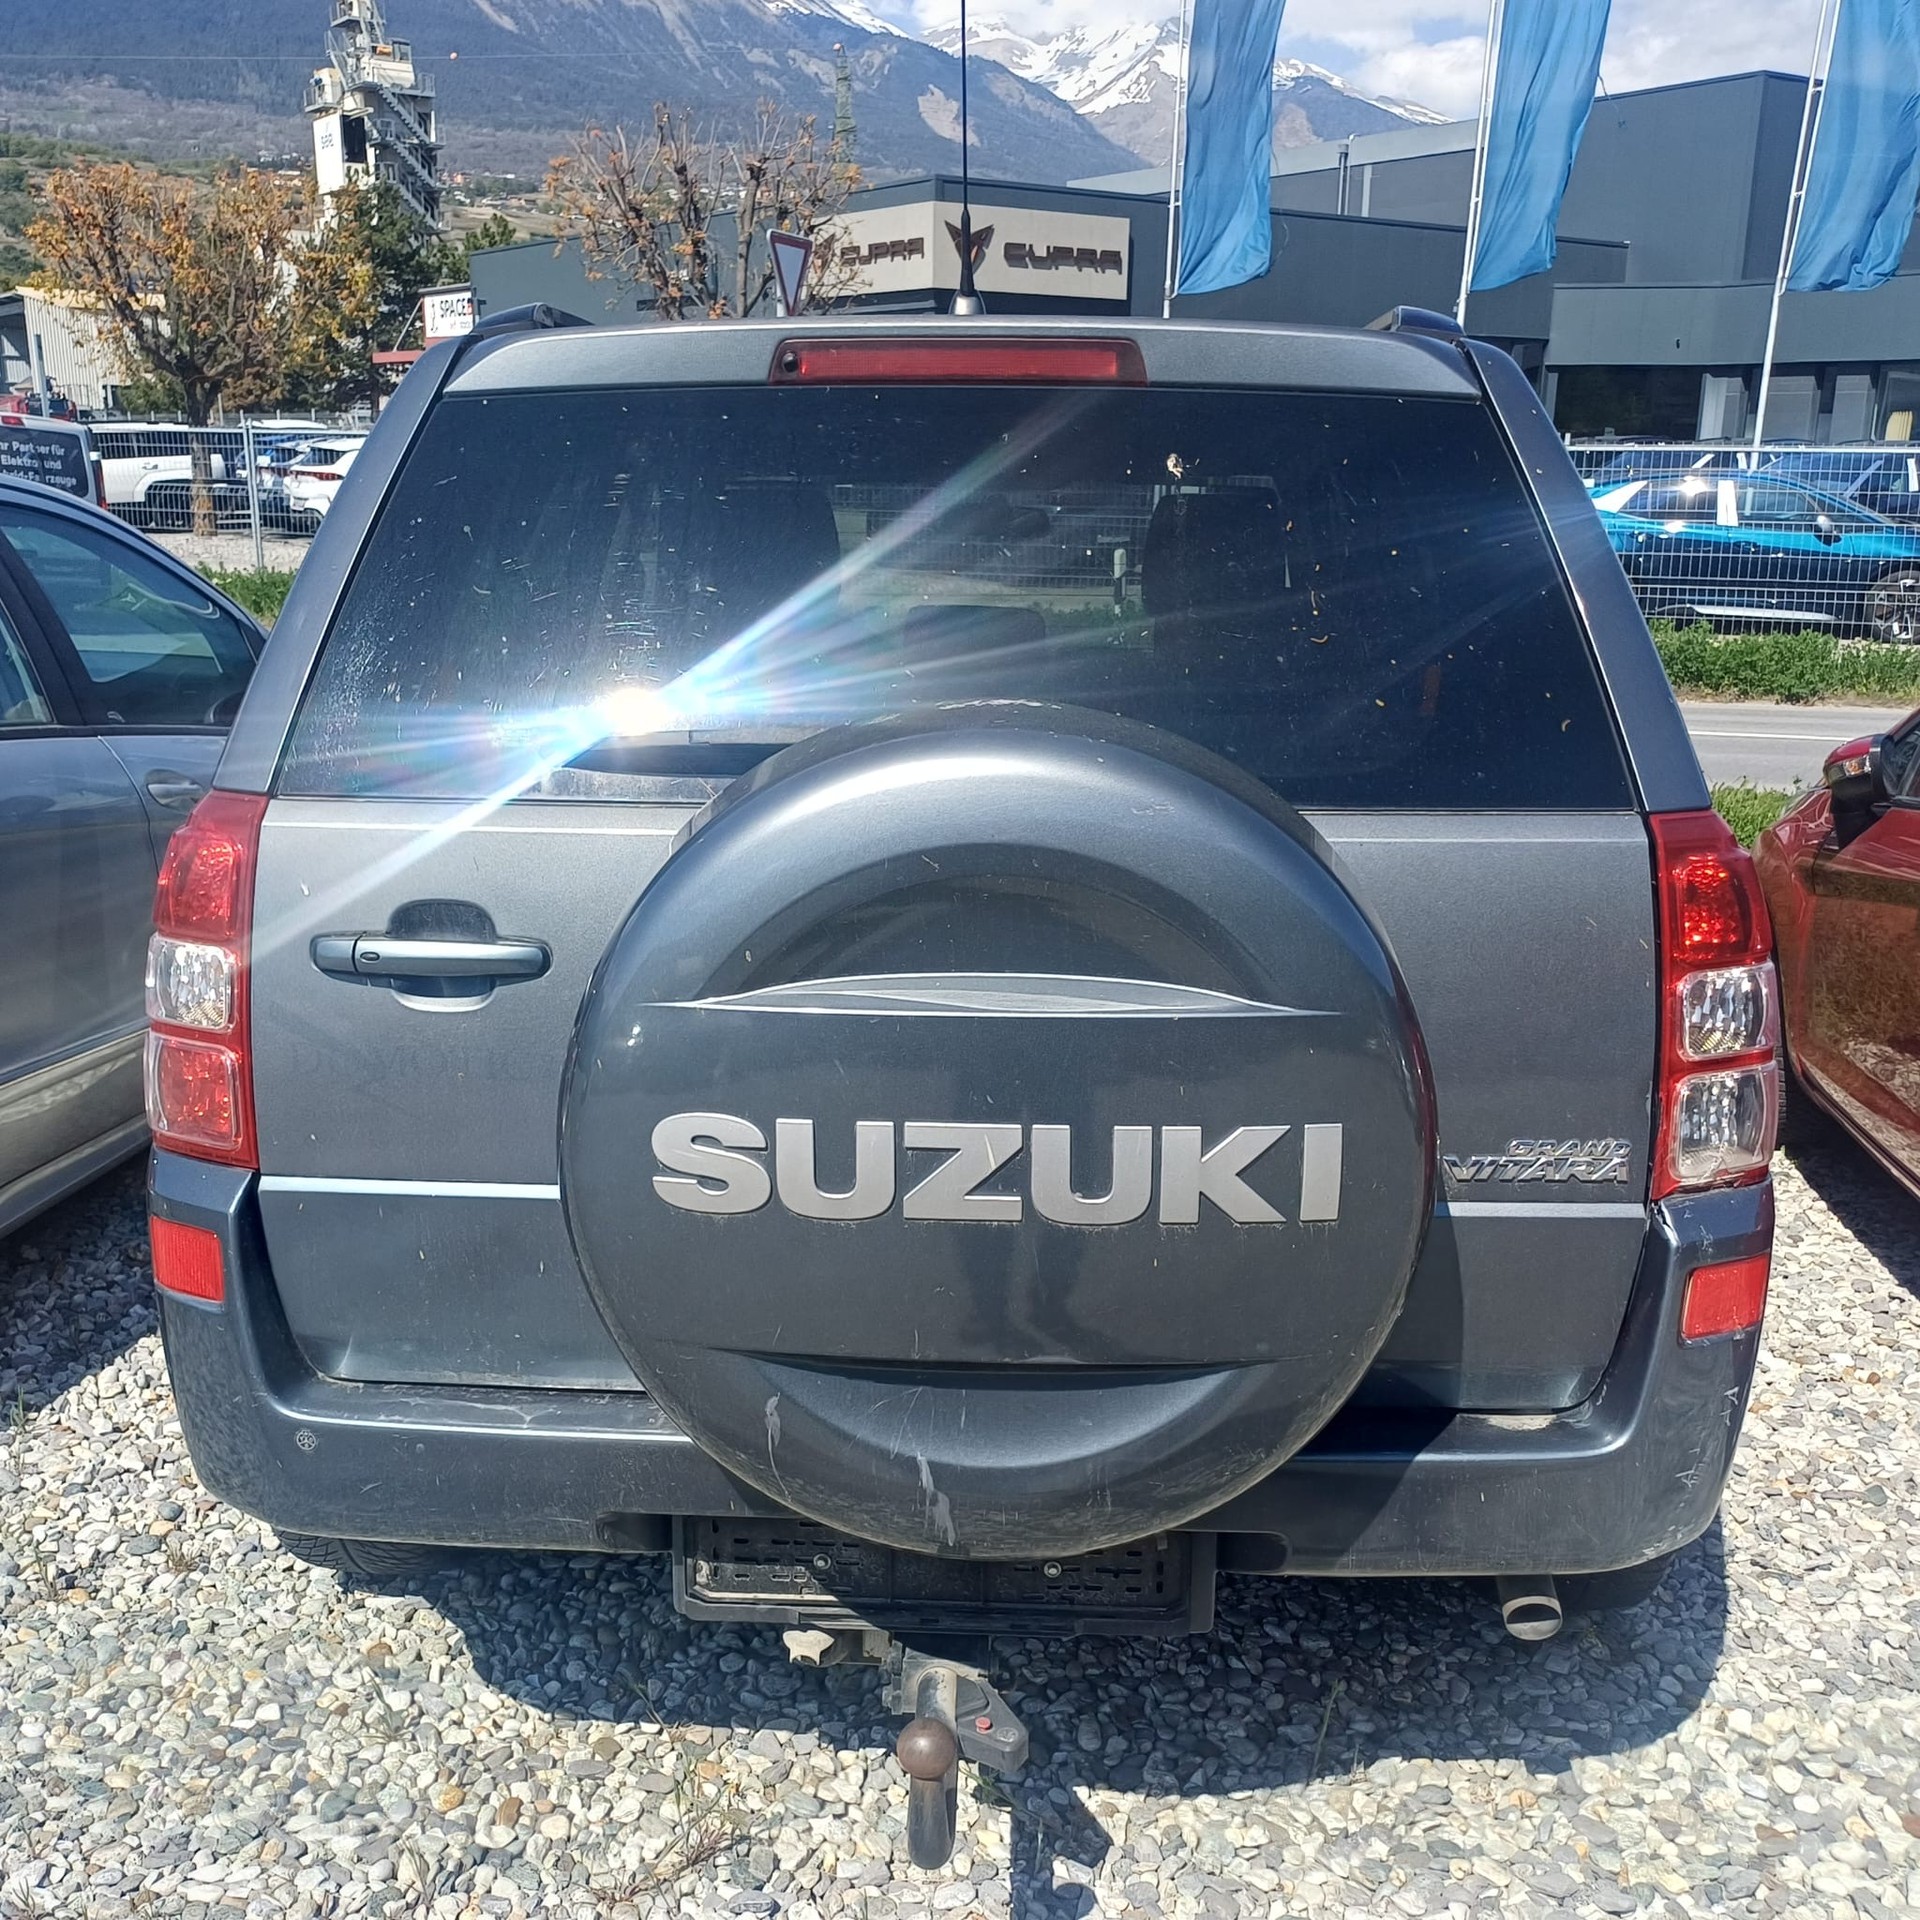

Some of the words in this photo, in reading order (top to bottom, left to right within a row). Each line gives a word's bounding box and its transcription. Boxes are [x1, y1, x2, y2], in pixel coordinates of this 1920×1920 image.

[840, 237, 925, 267] CUPRA
[1003, 242, 1123, 275] CUPRA
[44, 459, 62, 470] und
[1506, 1138, 1632, 1157] GRAND
[650, 1111, 1344, 1226] SUZUKI
[1442, 1155, 1631, 1184] VITARA
